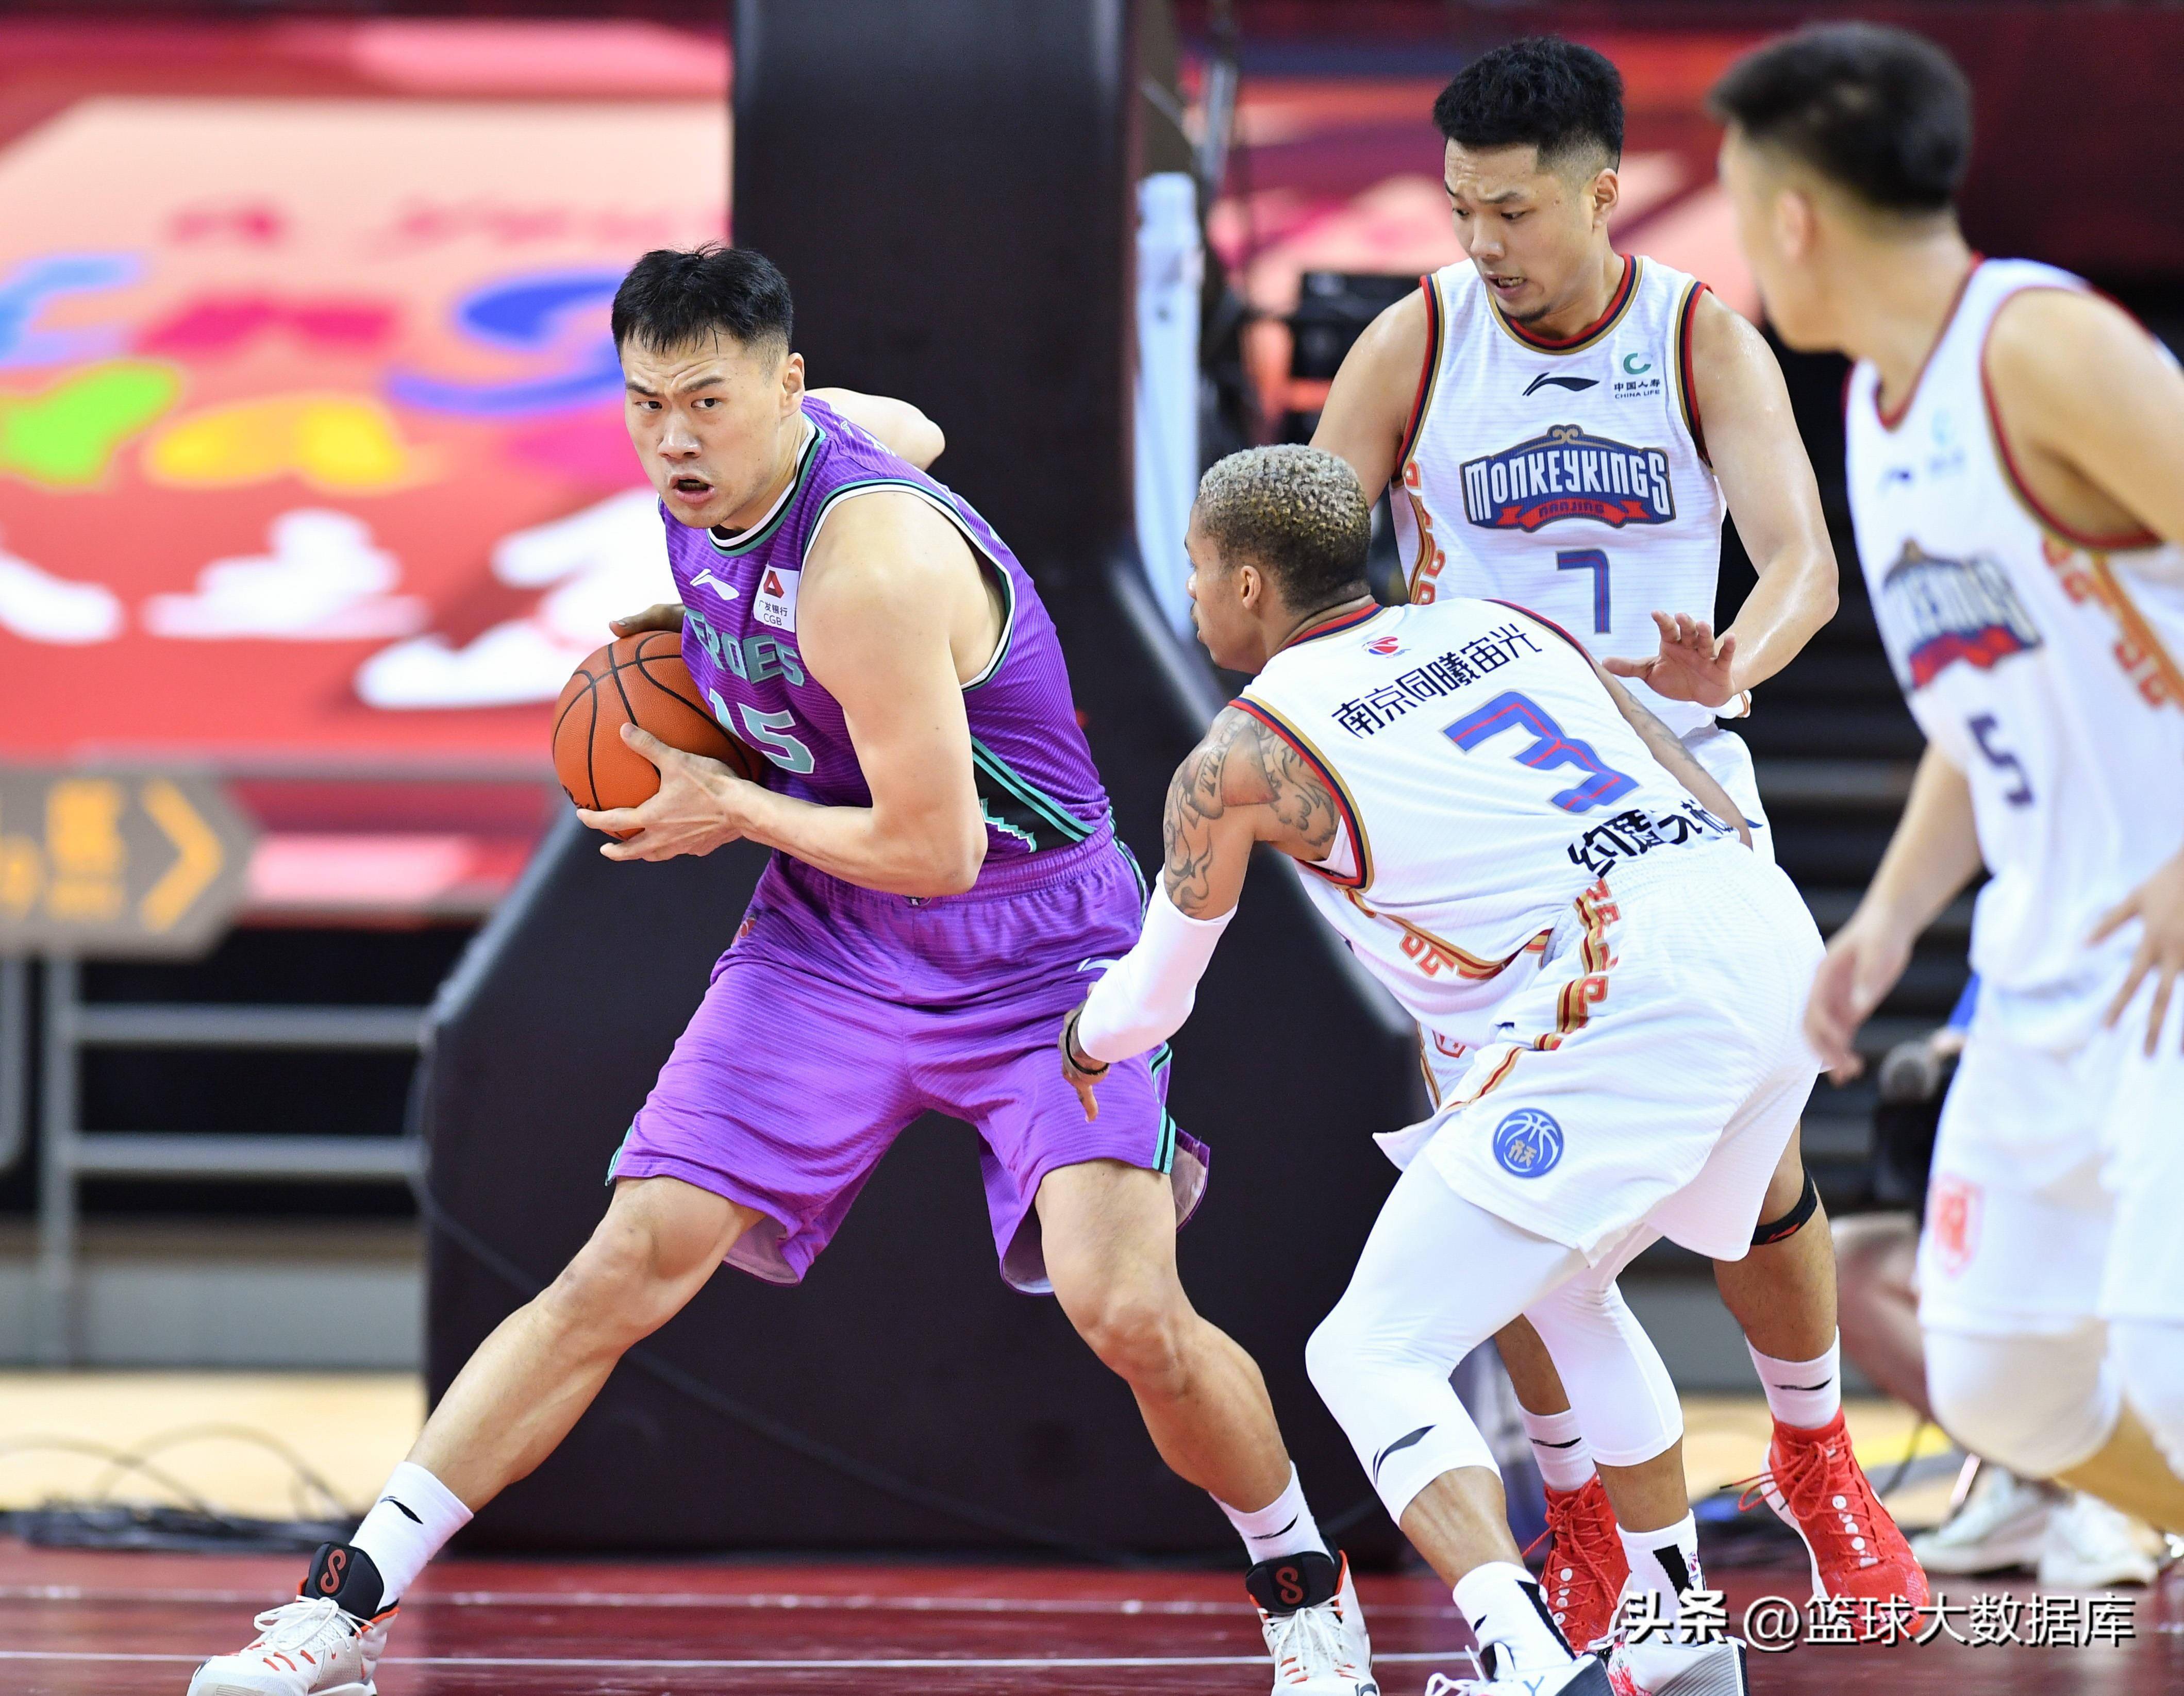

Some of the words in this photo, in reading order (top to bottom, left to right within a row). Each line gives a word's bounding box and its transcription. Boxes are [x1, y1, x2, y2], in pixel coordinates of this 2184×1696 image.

[1614, 378, 1660, 392] 中国人寿
[758, 599, 788, 617] 广发银行
[763, 613, 782, 626] CGB
[1556, 548, 1612, 634] 7
[685, 606, 805, 687] EROES
[1331, 623, 1543, 740] 南京同曦宙光
[708, 687, 815, 775] 15
[1439, 689, 1645, 815] 3
[1968, 713, 2034, 807] 5
